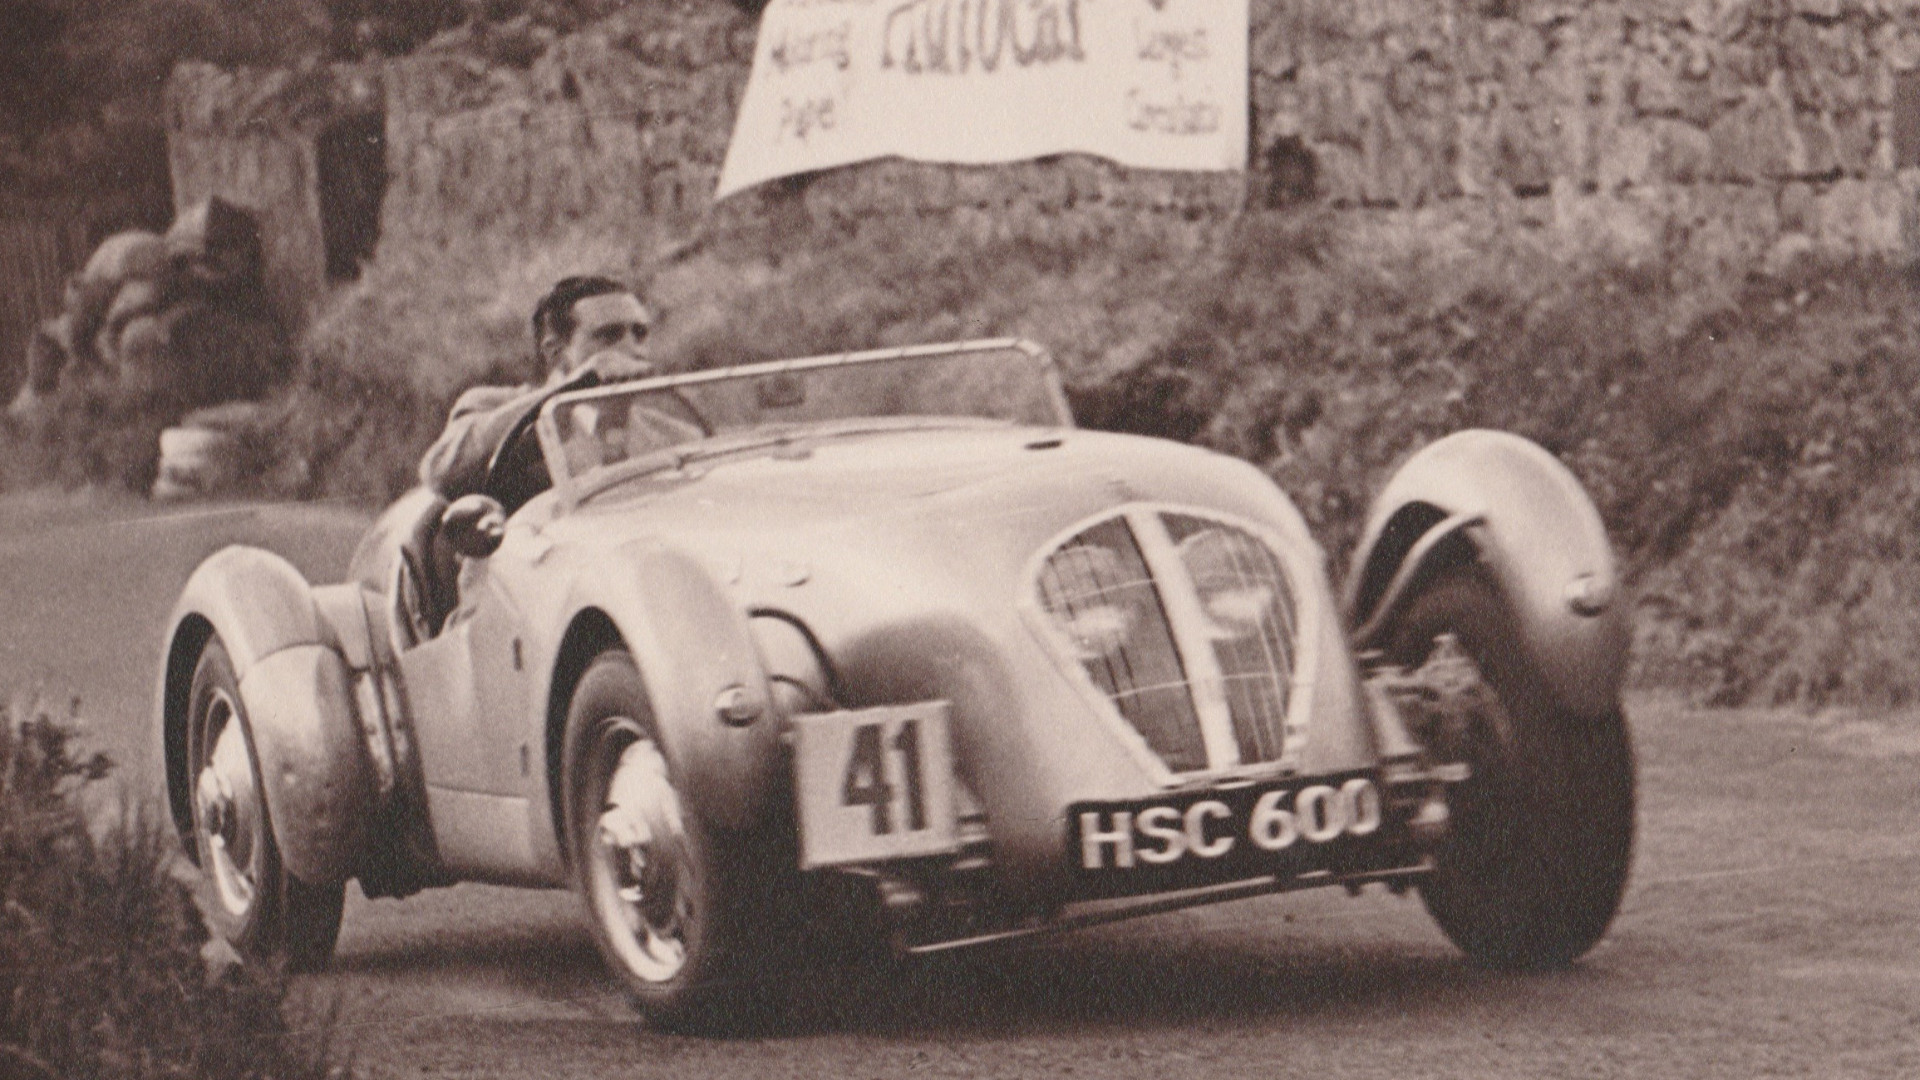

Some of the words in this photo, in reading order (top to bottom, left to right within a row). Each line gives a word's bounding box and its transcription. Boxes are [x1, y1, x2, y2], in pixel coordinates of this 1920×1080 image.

[842, 719, 928, 835] 41
[1080, 800, 1235, 869] HSC
[1250, 778, 1381, 850] 600
